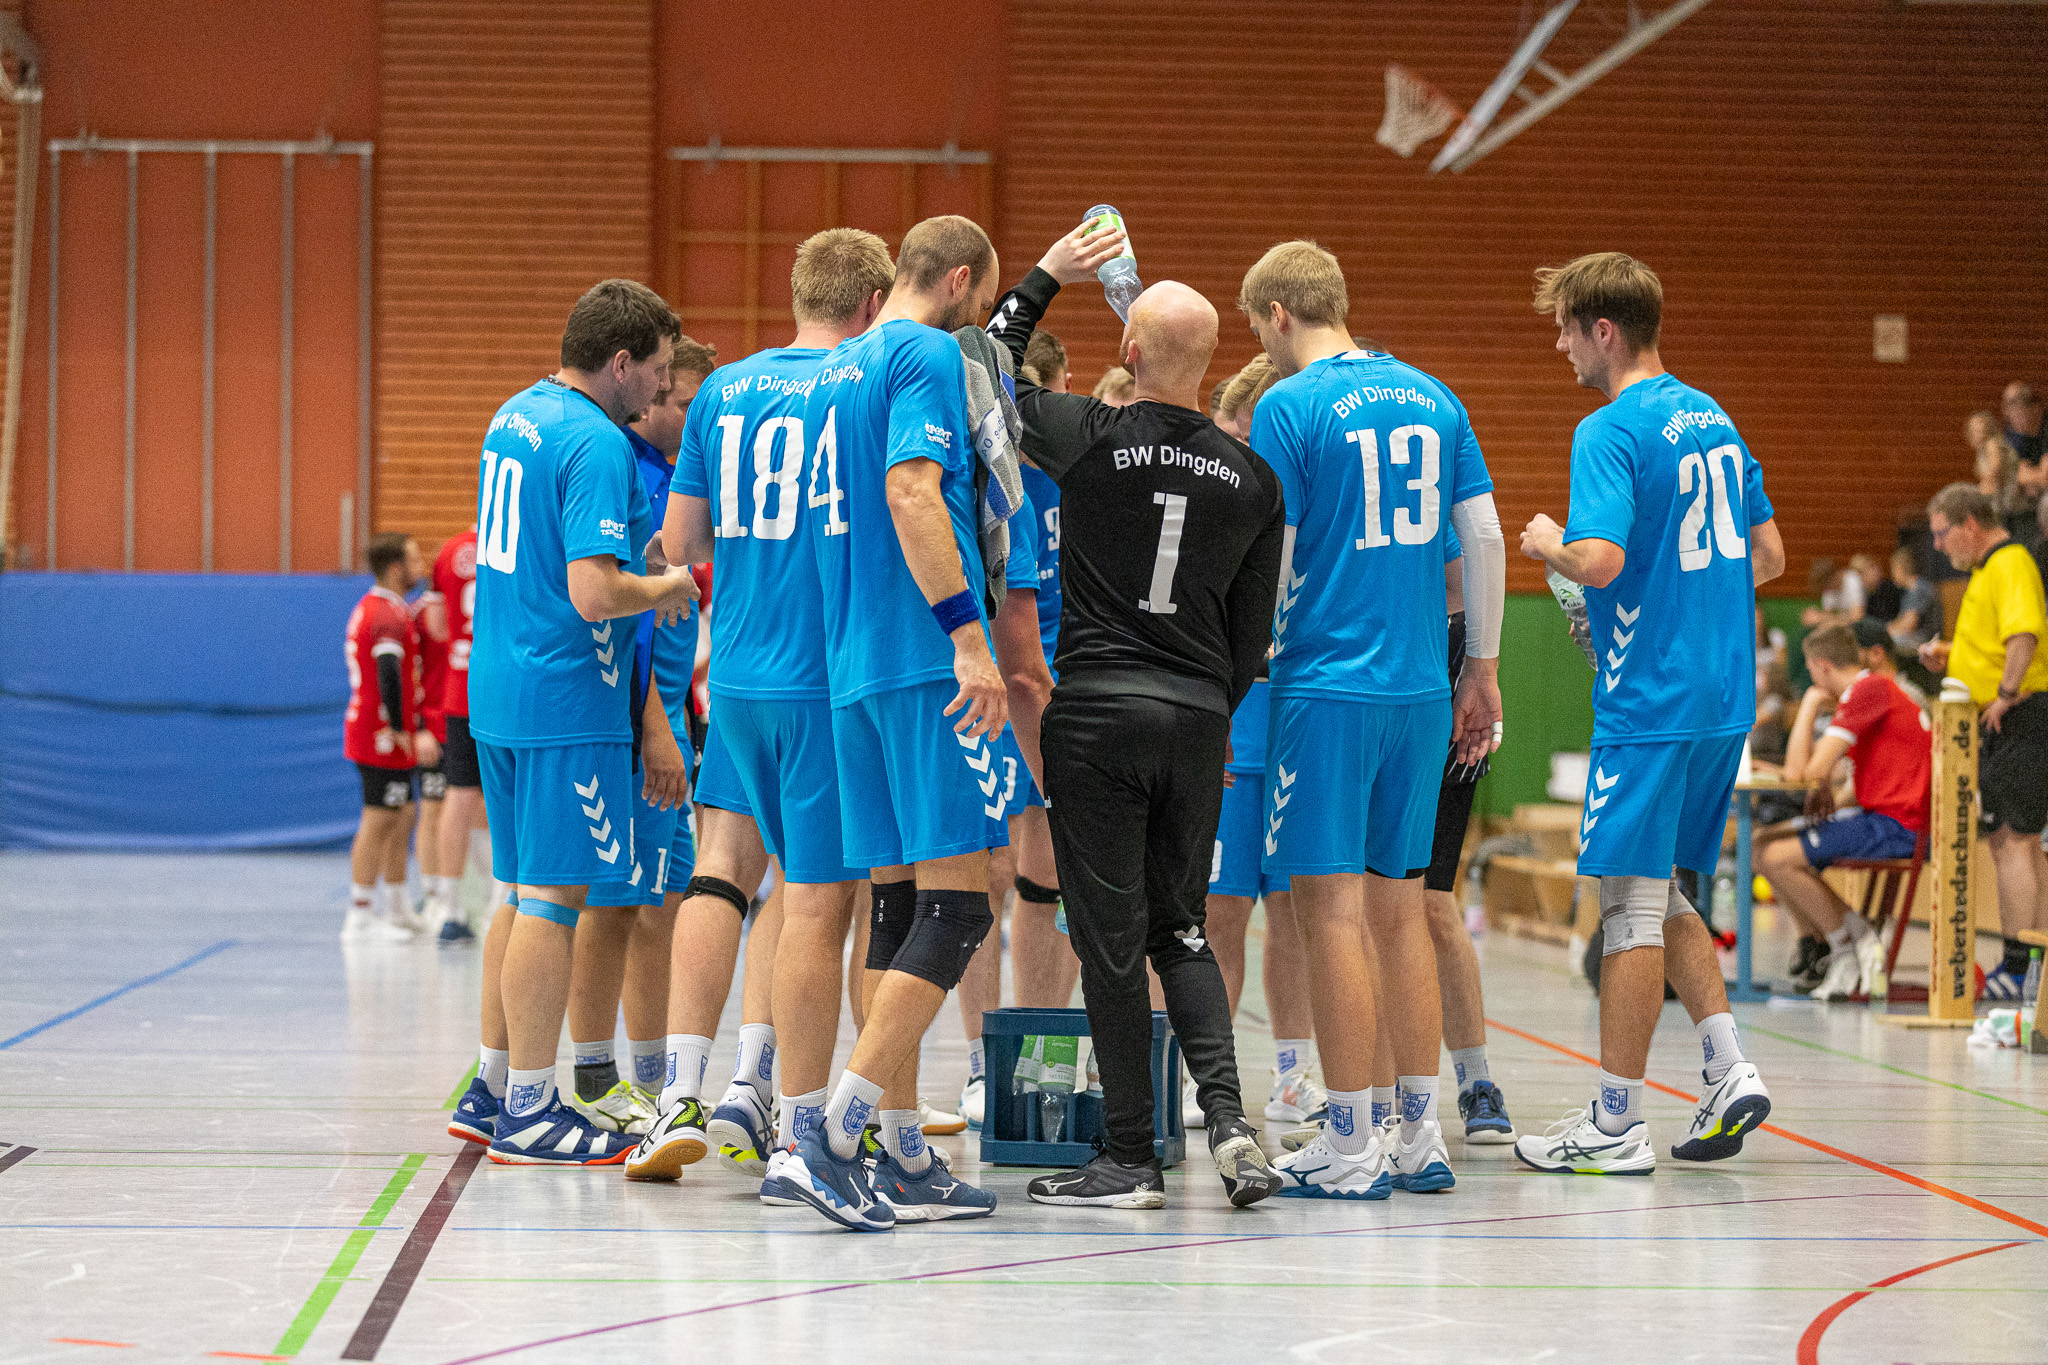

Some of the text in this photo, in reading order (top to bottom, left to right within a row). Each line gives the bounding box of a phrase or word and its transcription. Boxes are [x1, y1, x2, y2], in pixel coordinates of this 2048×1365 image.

[488, 412, 543, 453] BW Dingden
[721, 375, 753, 402] BW
[1332, 385, 1436, 419] BW Dingden
[1661, 413, 1686, 446] BW
[476, 449, 523, 574] 10
[714, 415, 805, 541] 18
[808, 405, 849, 537] 4
[1113, 445, 1241, 489] BW Dingden
[1345, 424, 1440, 550] 13
[1679, 444, 1746, 572] 20
[1138, 492, 1188, 614] 1
